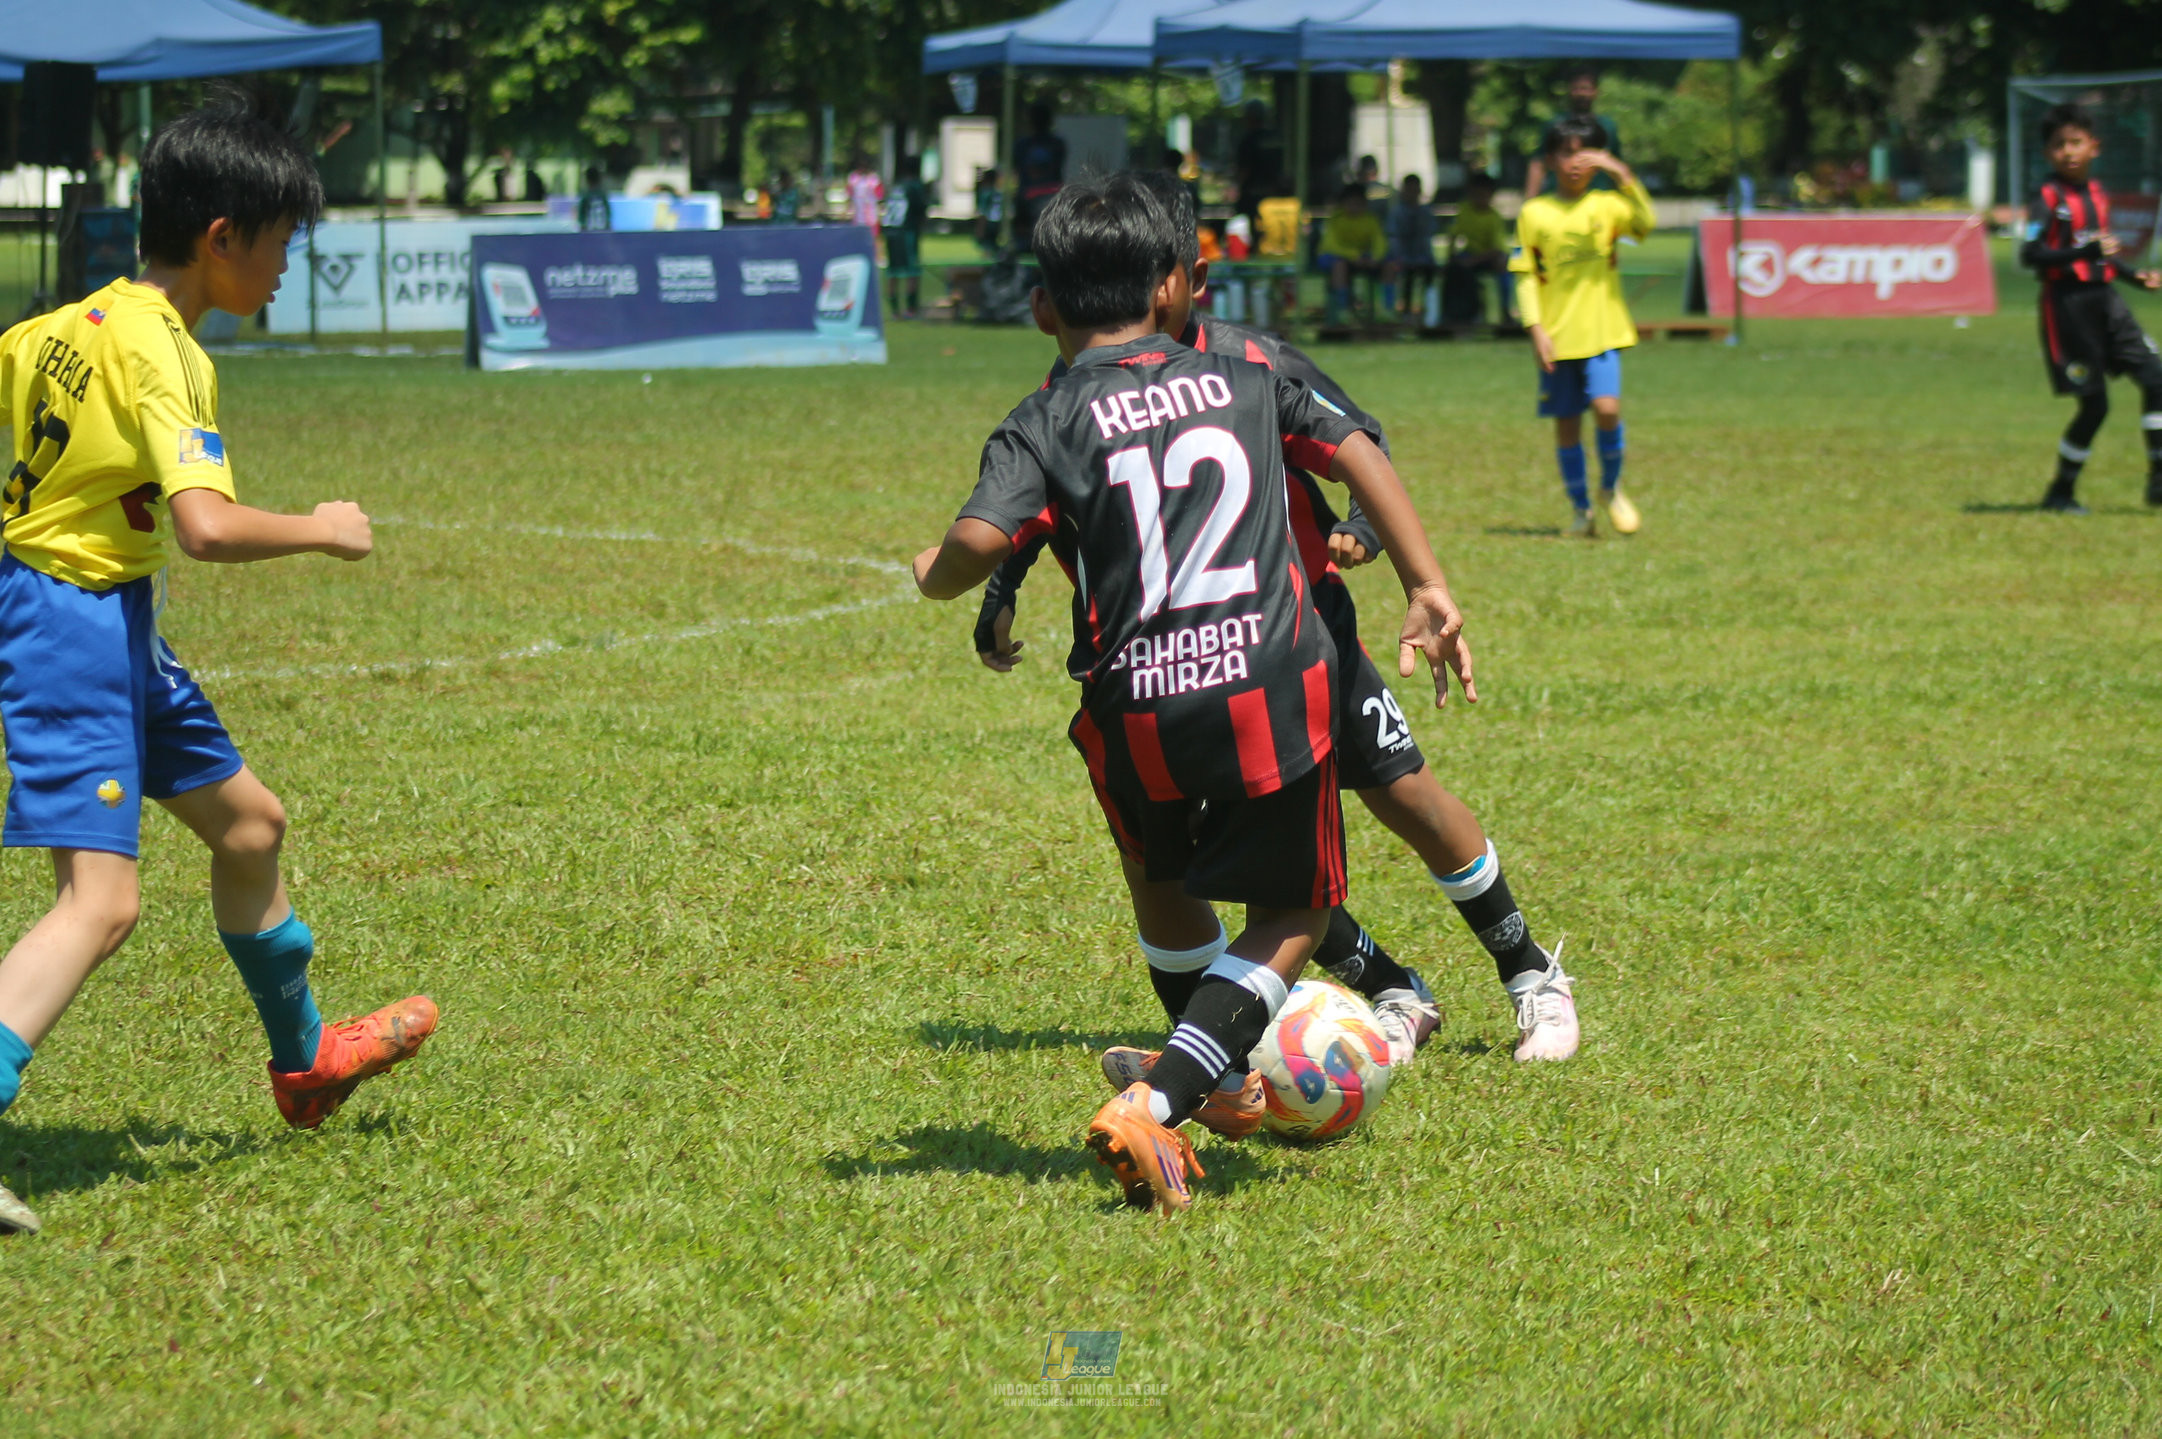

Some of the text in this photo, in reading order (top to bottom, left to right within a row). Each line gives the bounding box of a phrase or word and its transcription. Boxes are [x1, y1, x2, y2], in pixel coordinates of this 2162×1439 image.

[1090, 373, 1232, 440] KEANO
[1106, 425, 1259, 624] 12
[1132, 650, 1249, 700] MIRZA
[1362, 687, 1410, 750] 29
